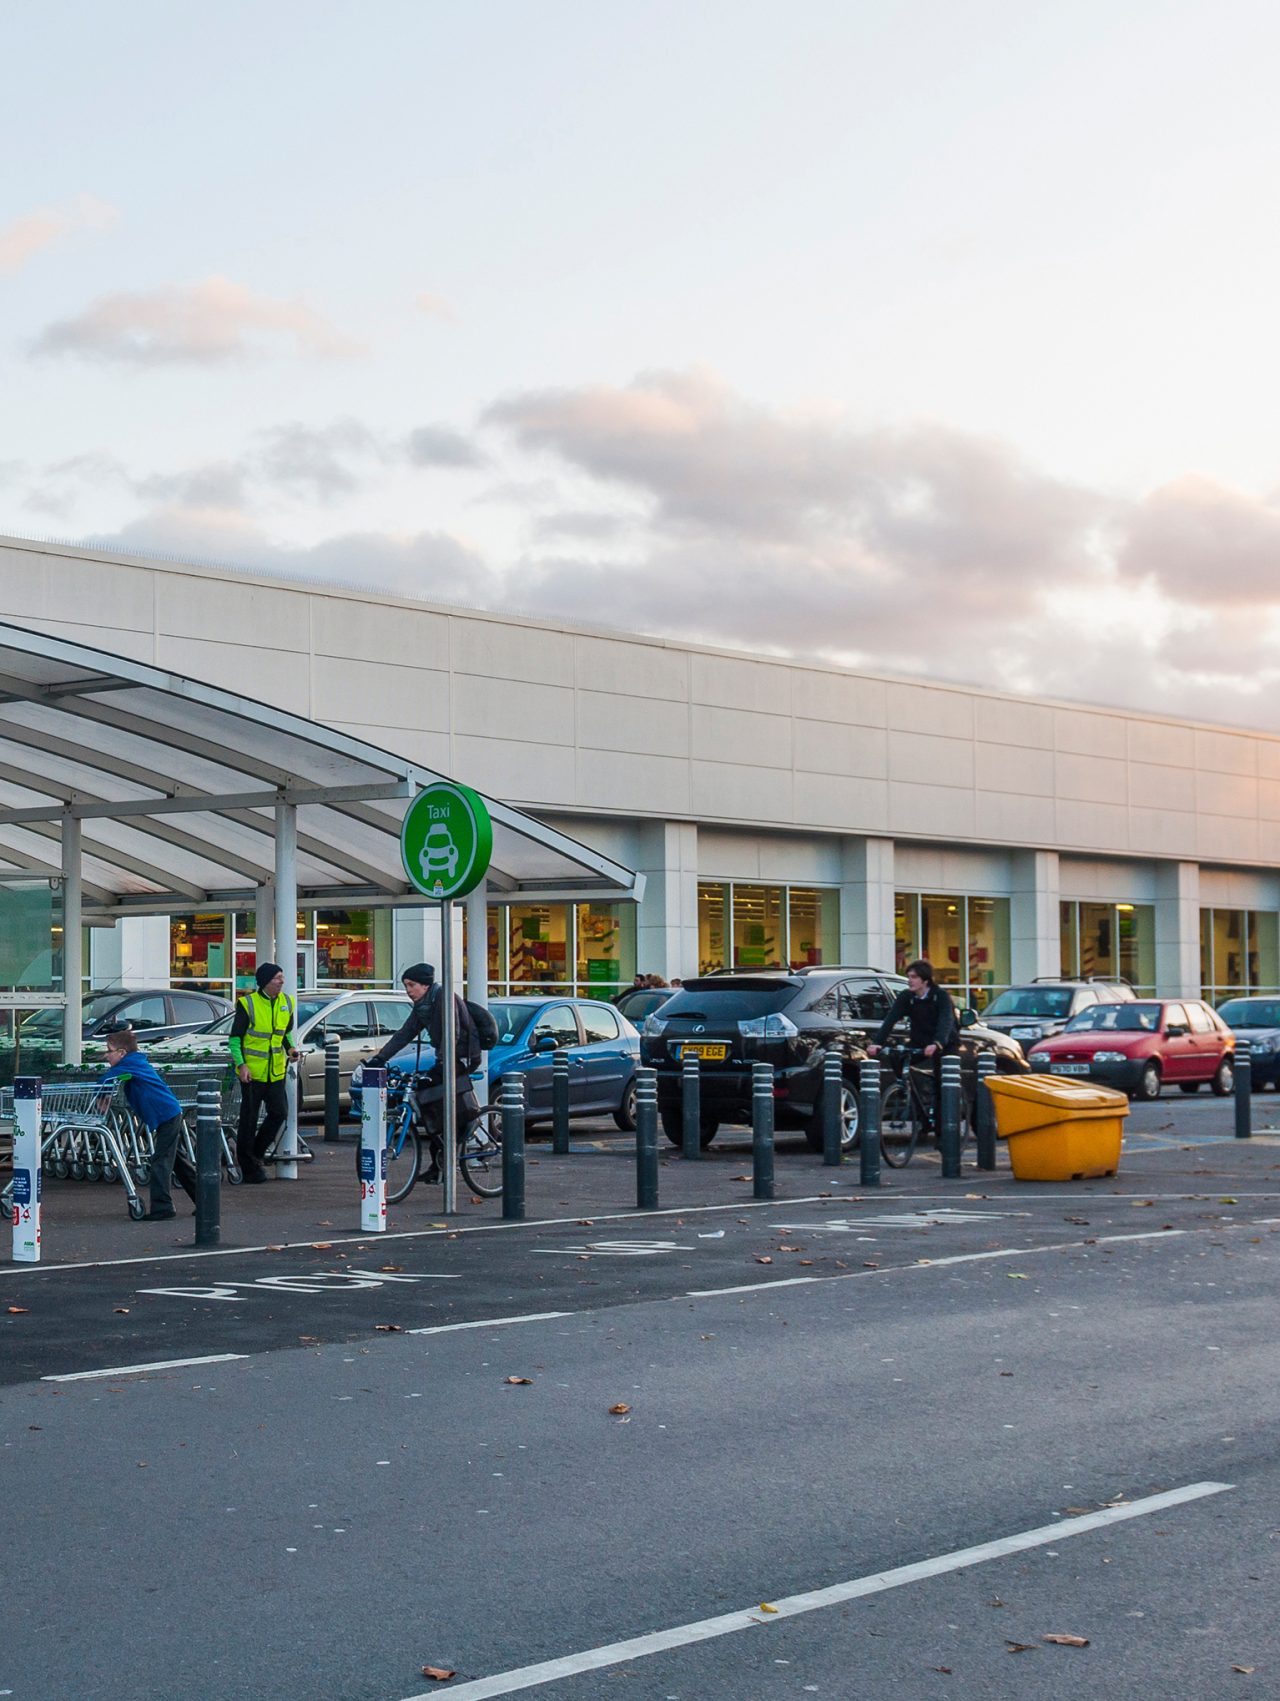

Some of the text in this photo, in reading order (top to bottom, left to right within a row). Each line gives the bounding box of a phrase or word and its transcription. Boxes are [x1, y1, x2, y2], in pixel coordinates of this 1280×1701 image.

[426, 802, 450, 820] Taxi
[135, 1269, 462, 1301] PICK
[529, 1240, 696, 1256] UP
